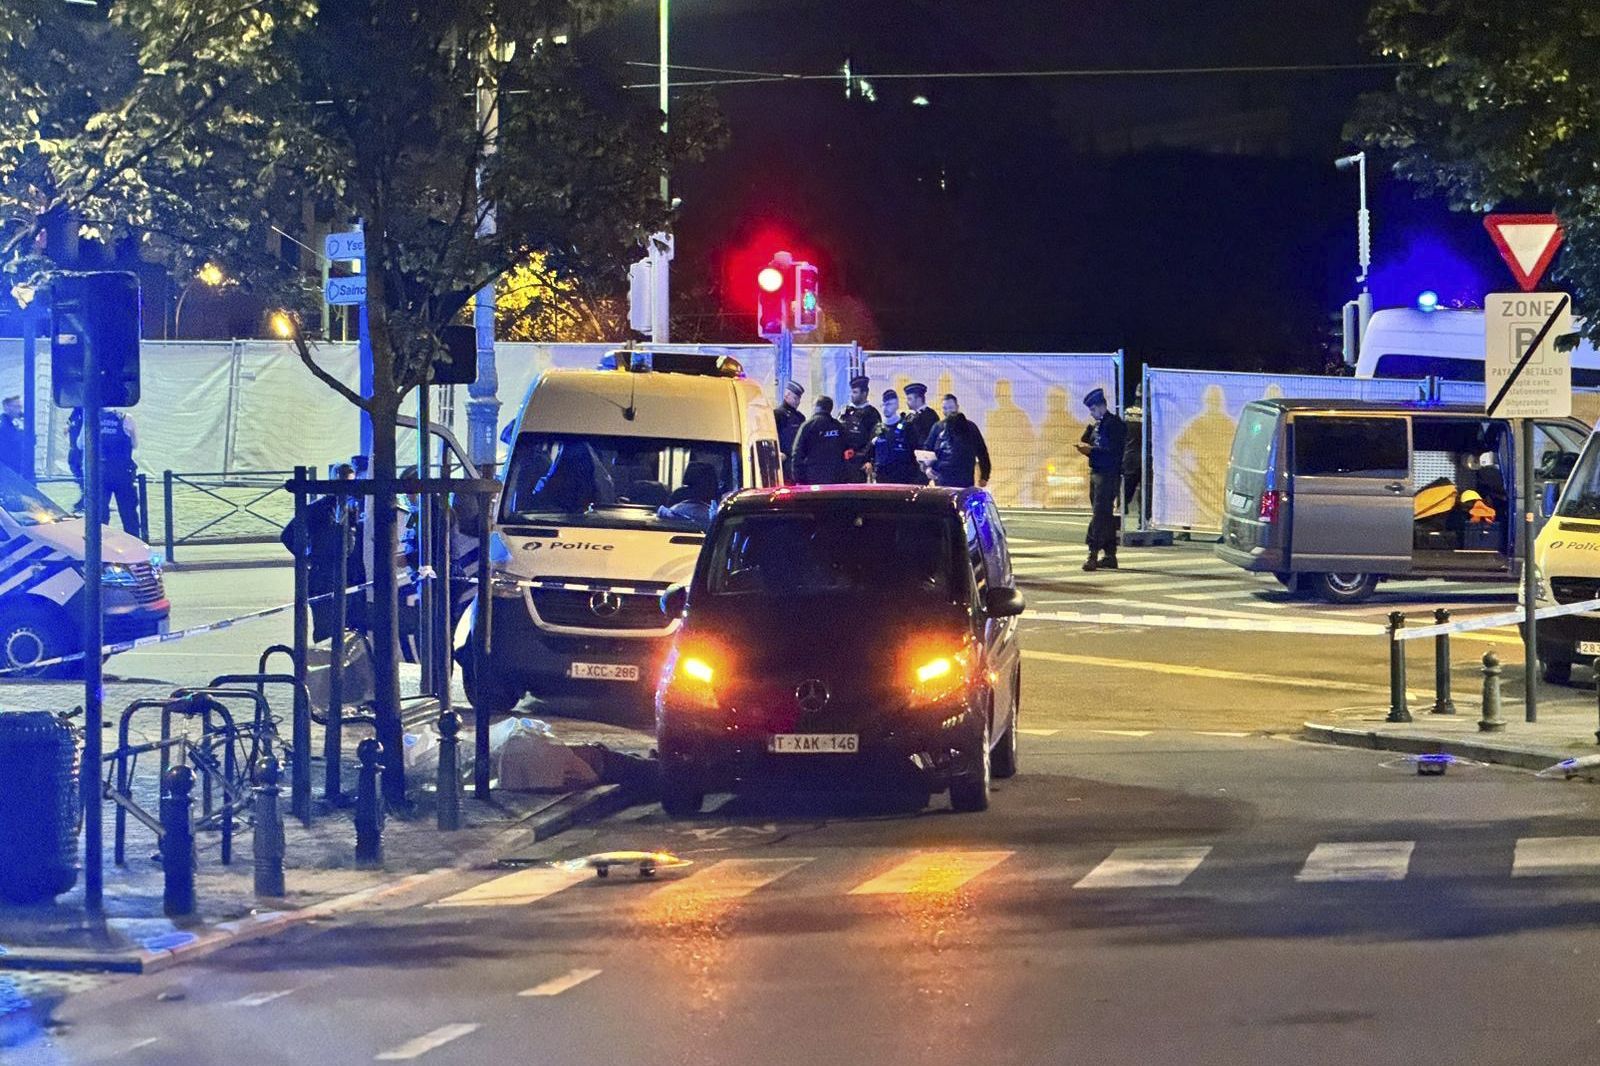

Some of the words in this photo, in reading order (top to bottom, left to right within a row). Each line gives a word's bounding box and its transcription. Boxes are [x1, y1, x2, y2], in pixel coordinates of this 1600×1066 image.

[1502, 301, 1554, 317] ZONE
[1515, 328, 1537, 359] P
[550, 541, 614, 551] Police
[1566, 541, 1600, 551] Polic
